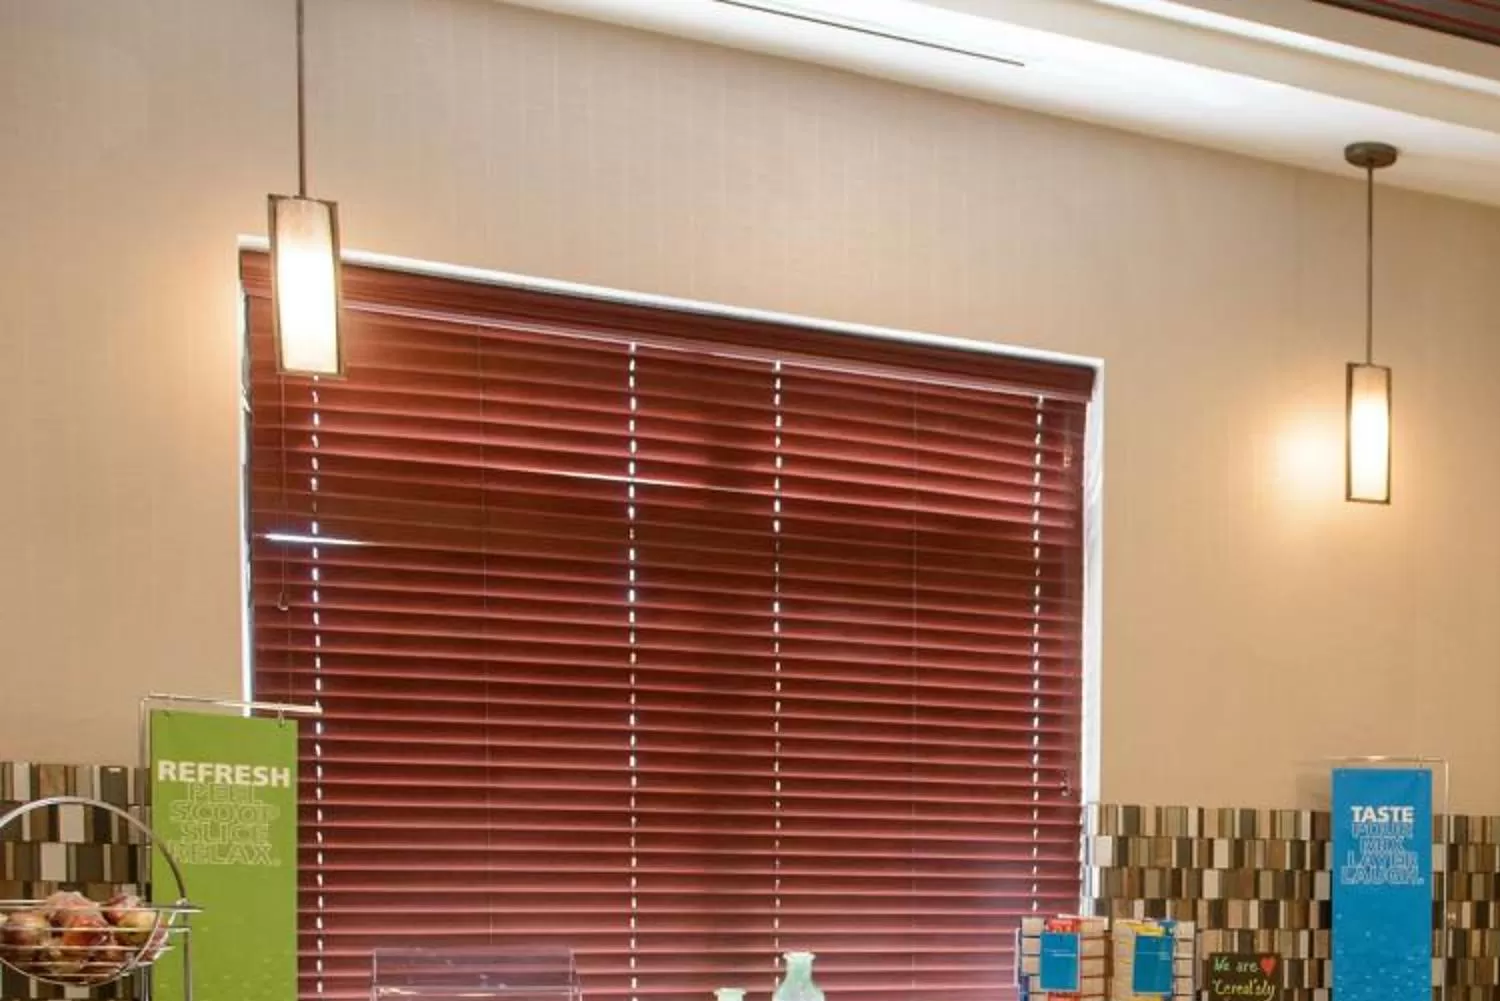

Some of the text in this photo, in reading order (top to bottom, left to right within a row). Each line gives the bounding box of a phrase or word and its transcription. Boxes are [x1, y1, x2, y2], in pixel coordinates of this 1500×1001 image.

[157, 760, 291, 788] REFRESH
[187, 782, 263, 804] PEEL
[169, 800, 281, 822] SCOOP
[1350, 805, 1416, 823] TASTE
[180, 819, 271, 844] SLICE
[1235, 960, 1259, 973] are
